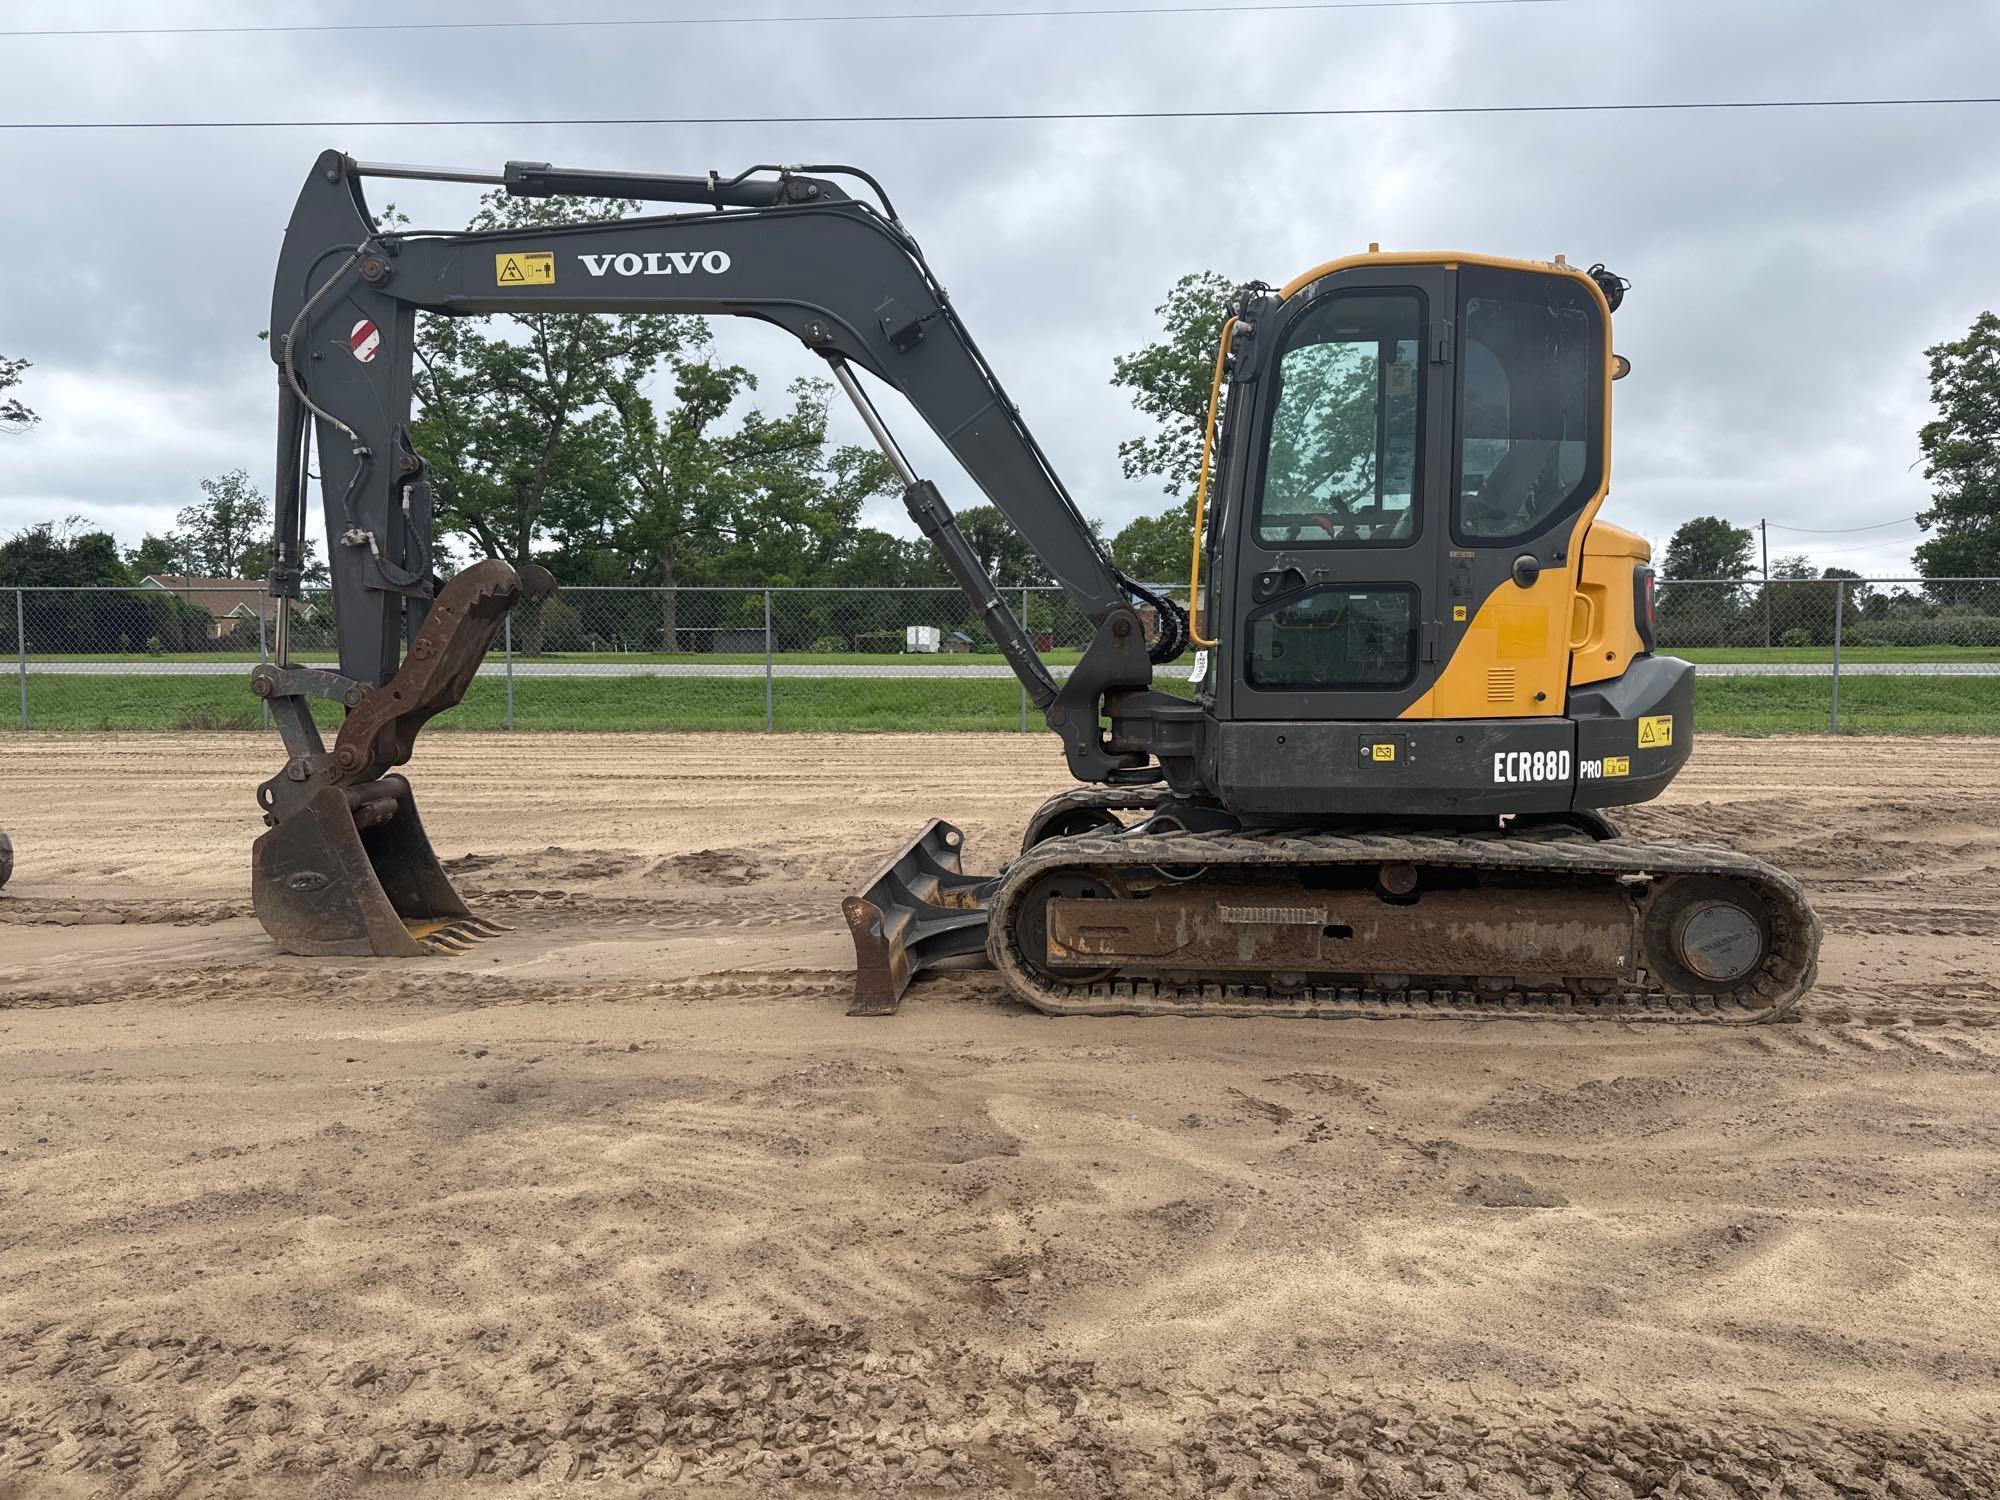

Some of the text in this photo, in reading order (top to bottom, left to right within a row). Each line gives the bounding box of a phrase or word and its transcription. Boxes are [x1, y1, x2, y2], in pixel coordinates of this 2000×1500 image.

[577, 250, 731, 276] VOLVO
[1494, 750, 1602, 783] ECR88D PRO
